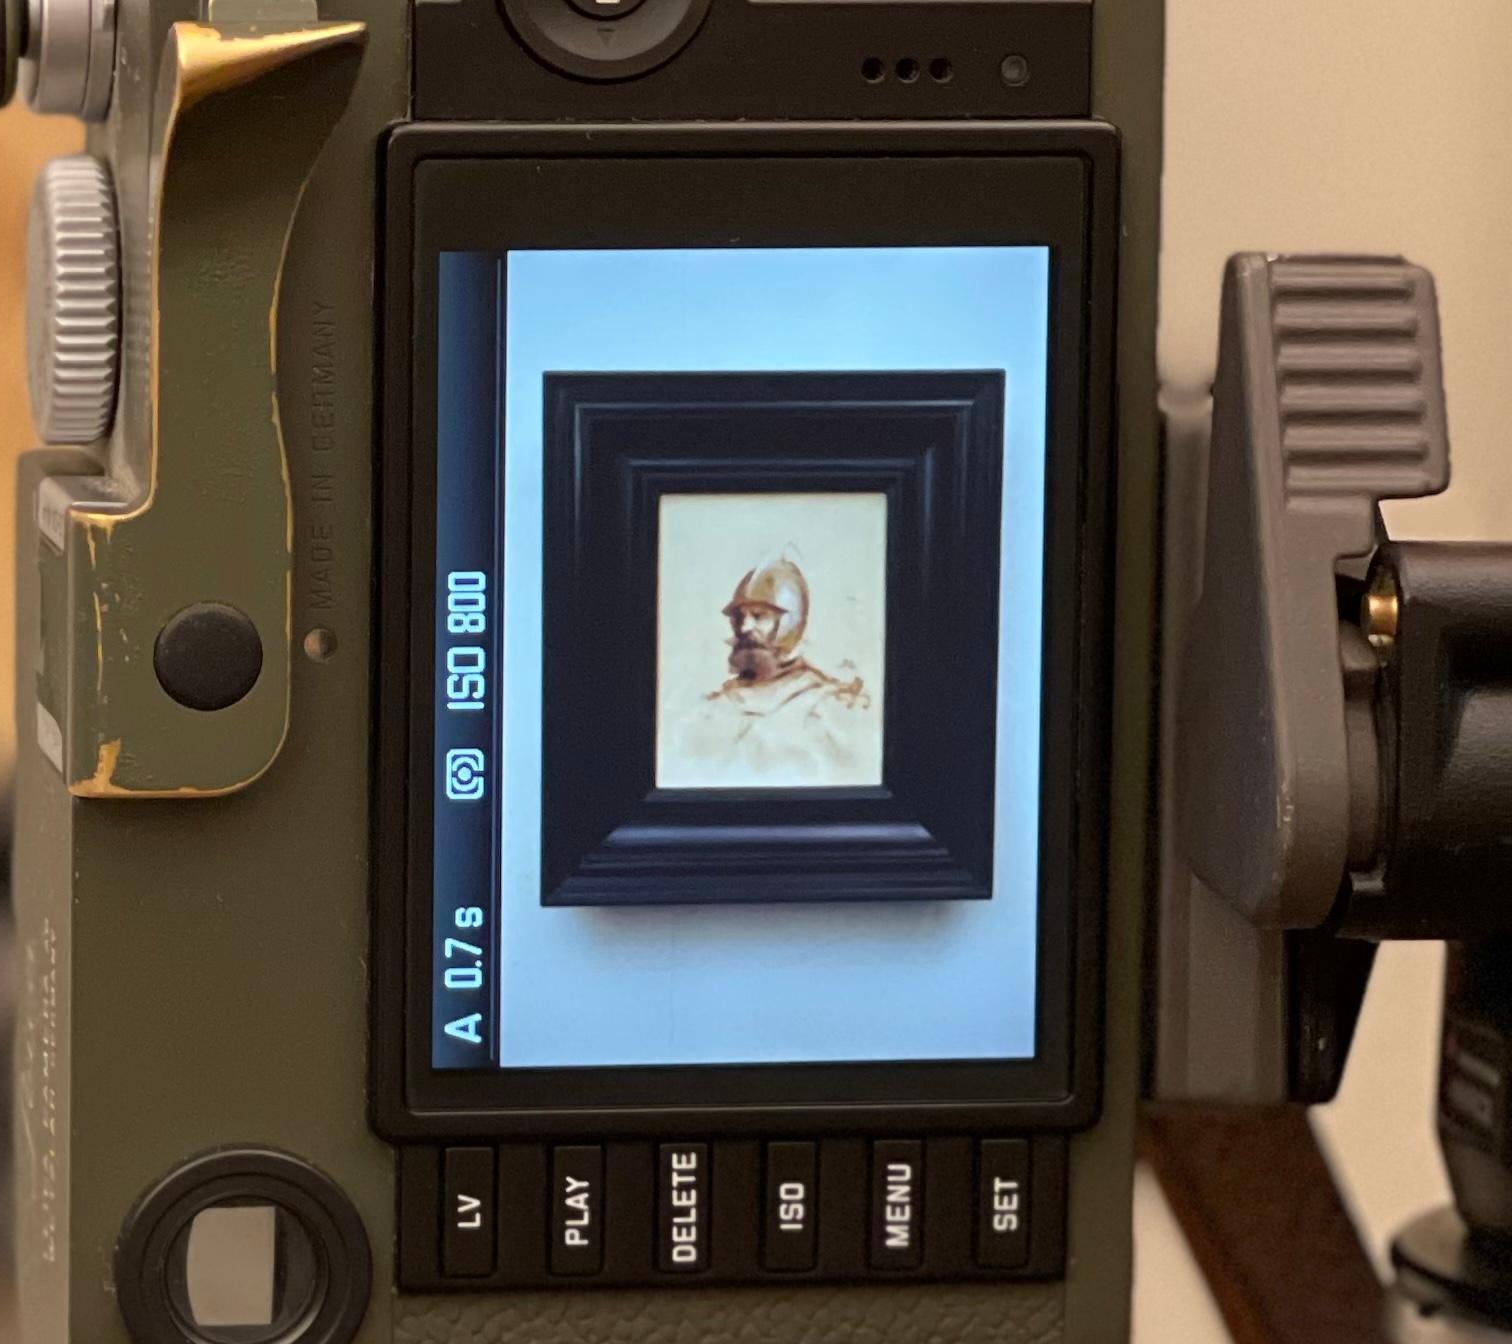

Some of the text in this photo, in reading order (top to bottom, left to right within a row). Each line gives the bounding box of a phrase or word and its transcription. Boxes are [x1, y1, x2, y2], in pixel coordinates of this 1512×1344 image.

[308, 298, 336, 610] MADE IN GERMANY
[443, 571, 486, 1044] A 0.7 s ISO 800
[457, 1194, 482, 1229] LV
[564, 1175, 590, 1246] PLAY
[671, 1151, 697, 1263] DELETE
[778, 1182, 805, 1231] ISO
[885, 1163, 912, 1248] MENU
[992, 1176, 1019, 1232] SET
